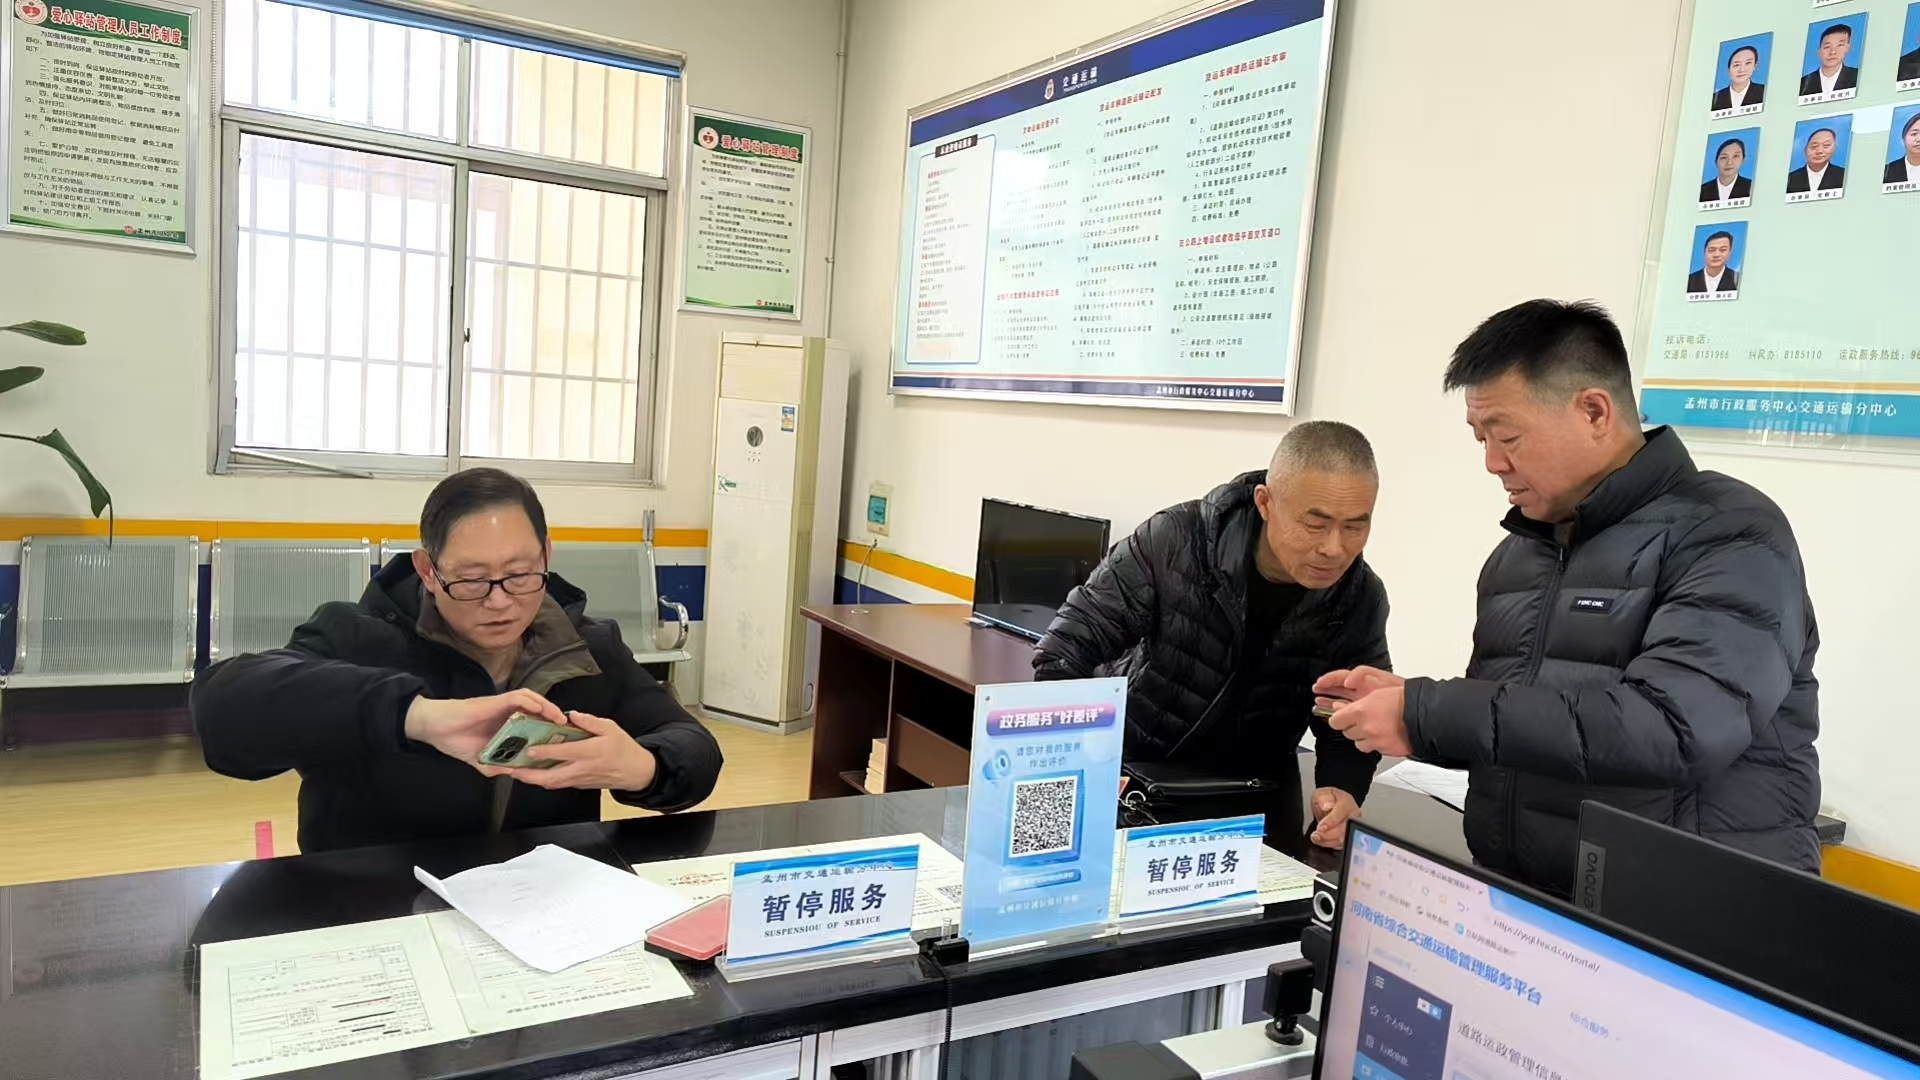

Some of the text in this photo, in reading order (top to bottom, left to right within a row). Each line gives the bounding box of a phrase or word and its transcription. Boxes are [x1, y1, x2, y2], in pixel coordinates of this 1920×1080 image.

[51, 6, 182, 45] 爱心驿站管理人员工作制度
[1684, 397, 1897, 417] 孟州市行政服务中心交通运输分中心
[1147, 849, 1239, 883] 暂停服务
[1584, 851, 1598, 914] enovo
[763, 883, 887, 923] 暂停服务
[827, 922, 840, 930] OF
[844, 915, 881, 927] SERVICE
[1351, 900, 1543, 1005] 河南省综合交通运输管理服务平台
